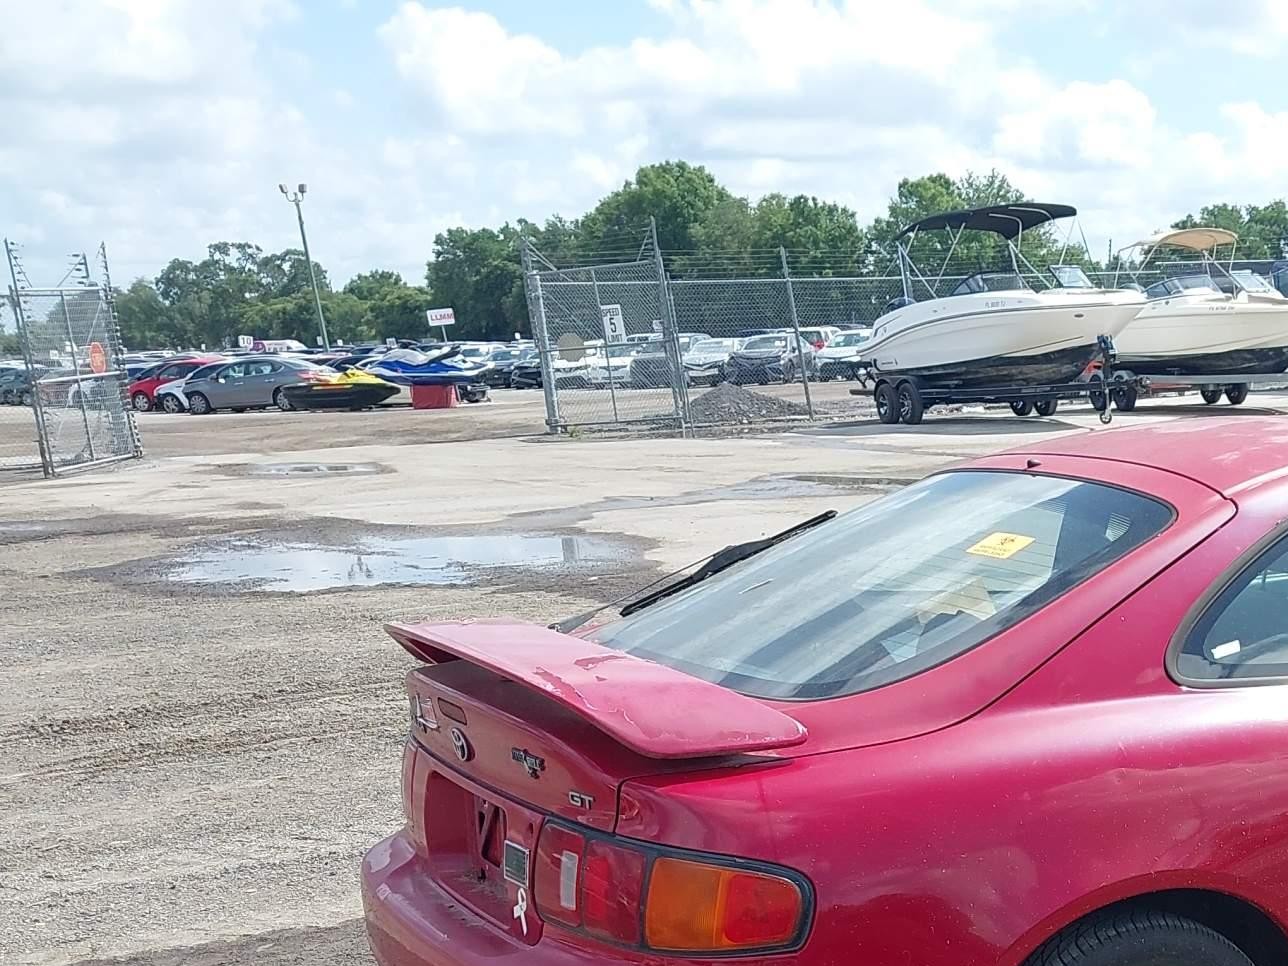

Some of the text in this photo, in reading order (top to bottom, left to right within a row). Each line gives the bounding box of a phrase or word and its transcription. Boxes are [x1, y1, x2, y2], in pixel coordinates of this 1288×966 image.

[601, 307, 620, 317] SPEED
[608, 317, 617, 333] 5
[241, 337, 252, 345] 10
[568, 790, 594, 810] GT
